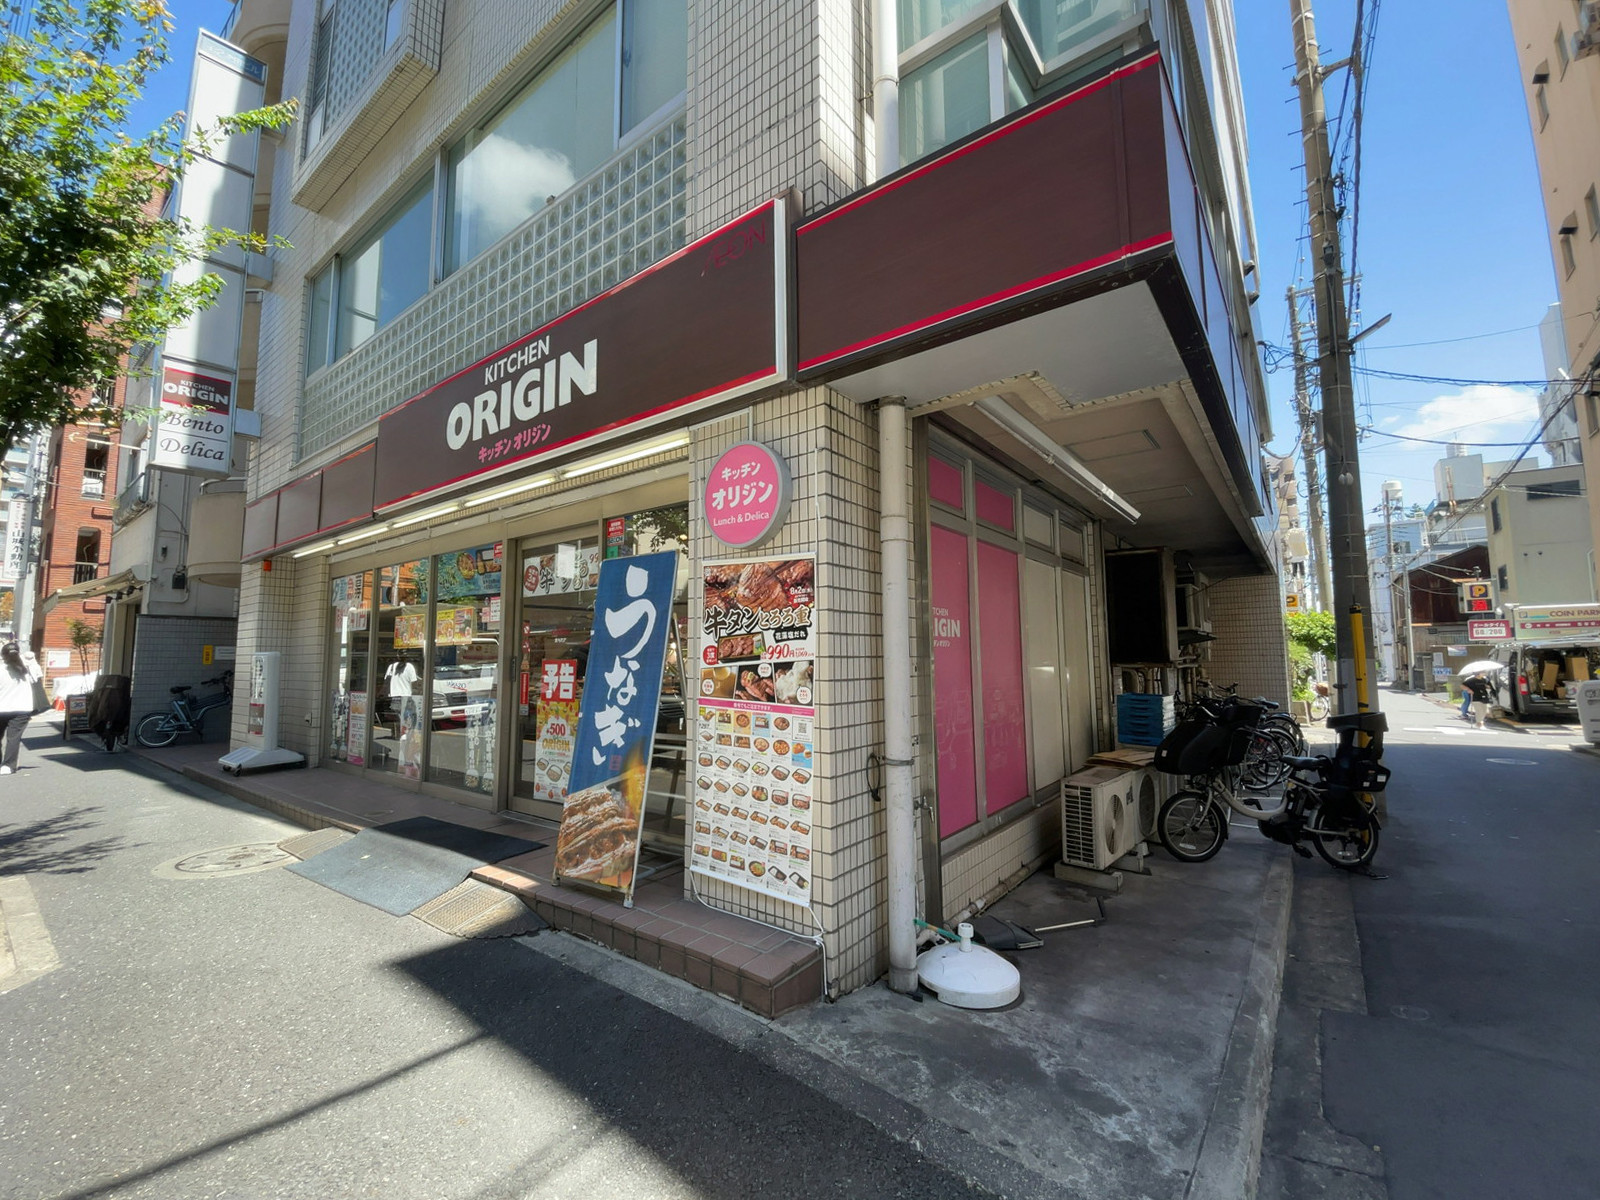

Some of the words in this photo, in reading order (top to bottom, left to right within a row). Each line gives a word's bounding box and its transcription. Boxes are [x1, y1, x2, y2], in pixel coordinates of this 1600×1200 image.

[484, 335, 550, 386] KITCHEN
[164, 382, 229, 405] ORIGIN
[180, 379, 215, 392] KITCHEN
[446, 338, 598, 451] ORIGIN
[167, 413, 225, 434] Bento
[160, 437, 225, 461] Delica
[478, 438, 512, 464] キッチン
[513, 423, 551, 451] オリジン
[721, 461, 761, 481] キッチン
[711, 481, 774, 511] オリジン
[713, 517, 736, 527] Lunch
[737, 513, 743, 522] &
[744, 511, 770, 522] Delica
[704, 605, 812, 641] 牛タンとろろ重
[932, 607, 949, 616] TCHEN
[933, 617, 961, 638] IGIN
[591, 564, 658, 767] うなぎ
[543, 662, 575, 700] 予告
[542, 738, 571, 752] ORIGIN
